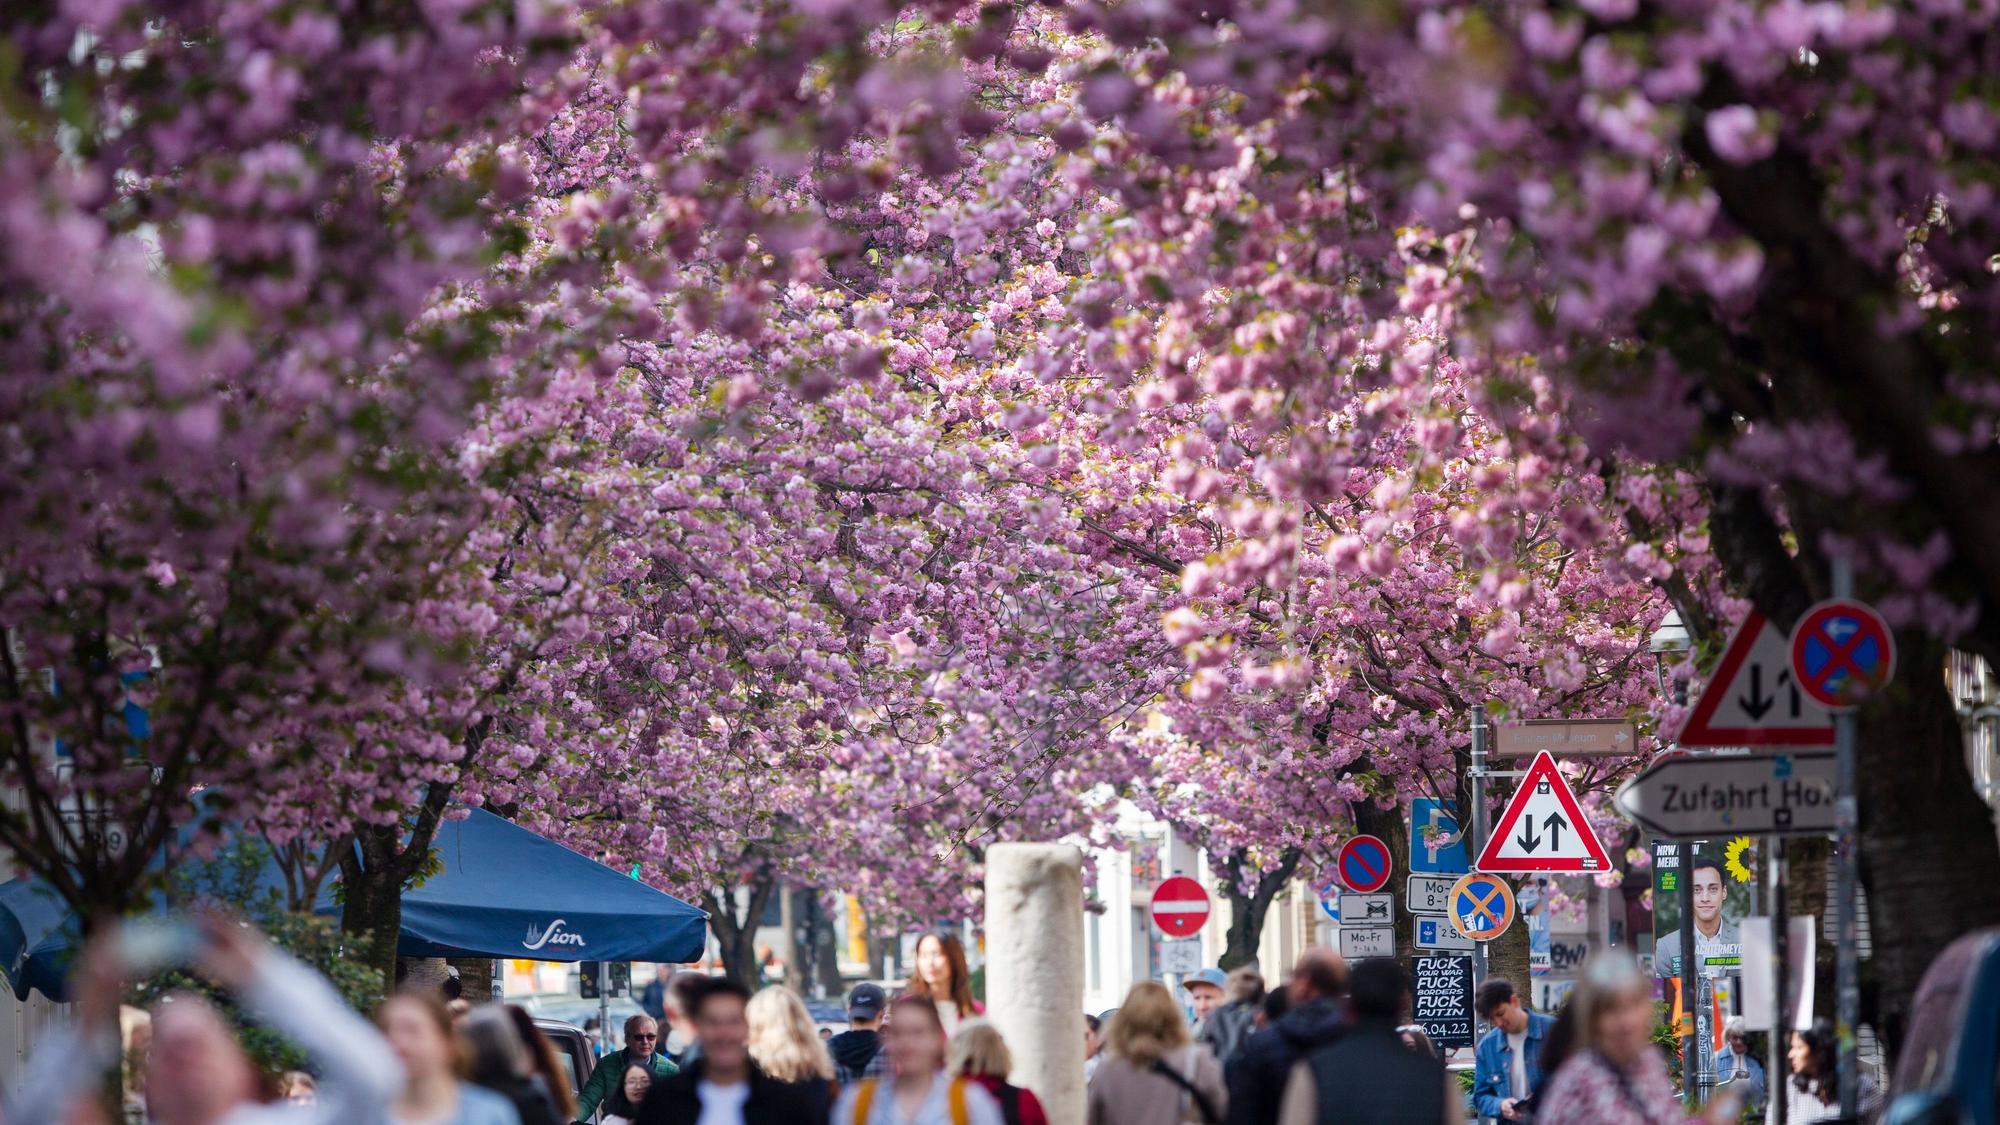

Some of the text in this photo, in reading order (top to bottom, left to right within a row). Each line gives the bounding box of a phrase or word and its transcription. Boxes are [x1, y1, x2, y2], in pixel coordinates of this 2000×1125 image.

[1662, 782, 1770, 813] Zufahrt
[1656, 845, 1676, 856] NRW
[1656, 857, 1679, 868] MEHR
[522, 919, 586, 950] Sion
[1351, 932, 1381, 942] Mo-Fr
[1441, 929, 1447, 937] 2
[1416, 957, 1463, 970] FUCK
[1416, 976, 1464, 989] FUCK
[1417, 995, 1464, 1008] FUCK
[1418, 1008, 1464, 1016] PUTIN
[1421, 1022, 1469, 1036] 6.04.22
